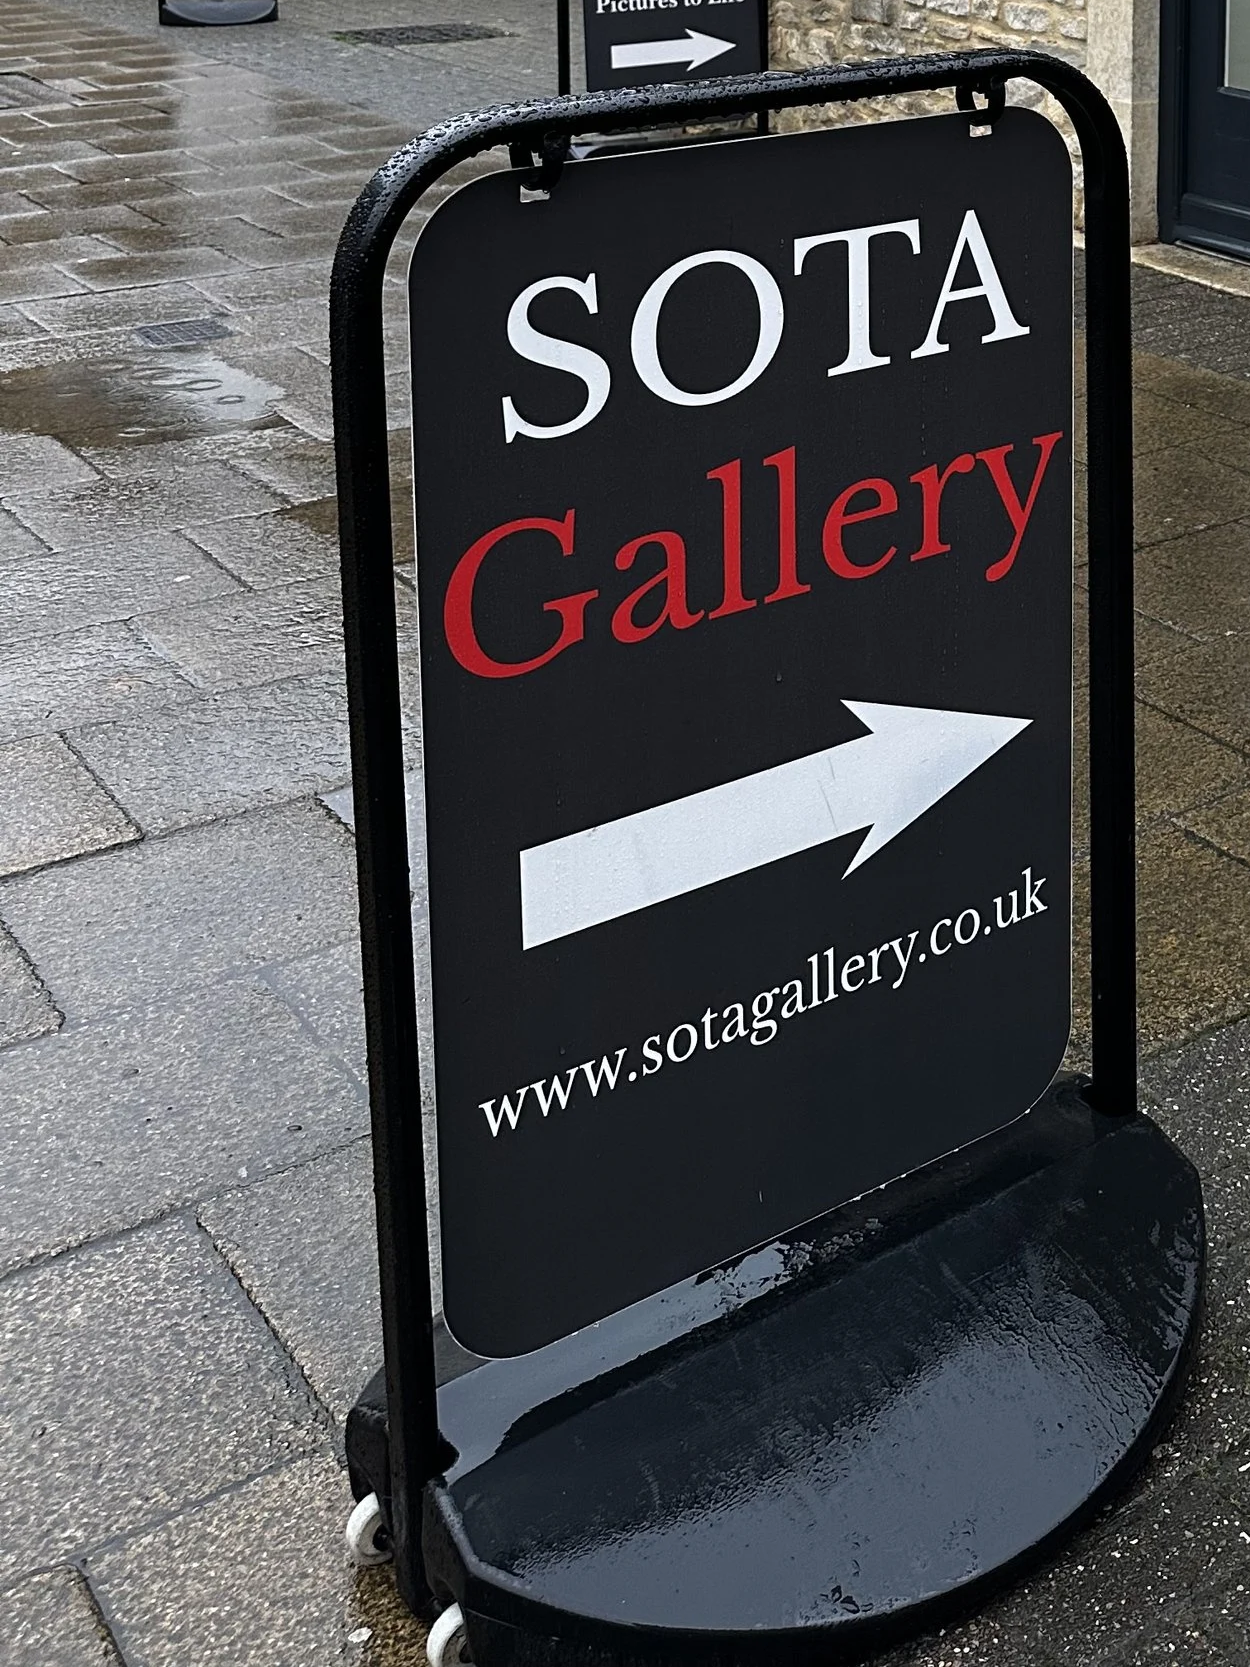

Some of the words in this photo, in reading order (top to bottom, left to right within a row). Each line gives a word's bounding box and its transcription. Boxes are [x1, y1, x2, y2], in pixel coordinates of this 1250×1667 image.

[501, 208, 1031, 444] SOTA
[443, 430, 1063, 679] Gallery
[478, 866, 1048, 1138] www.sotagallery.co.uk
